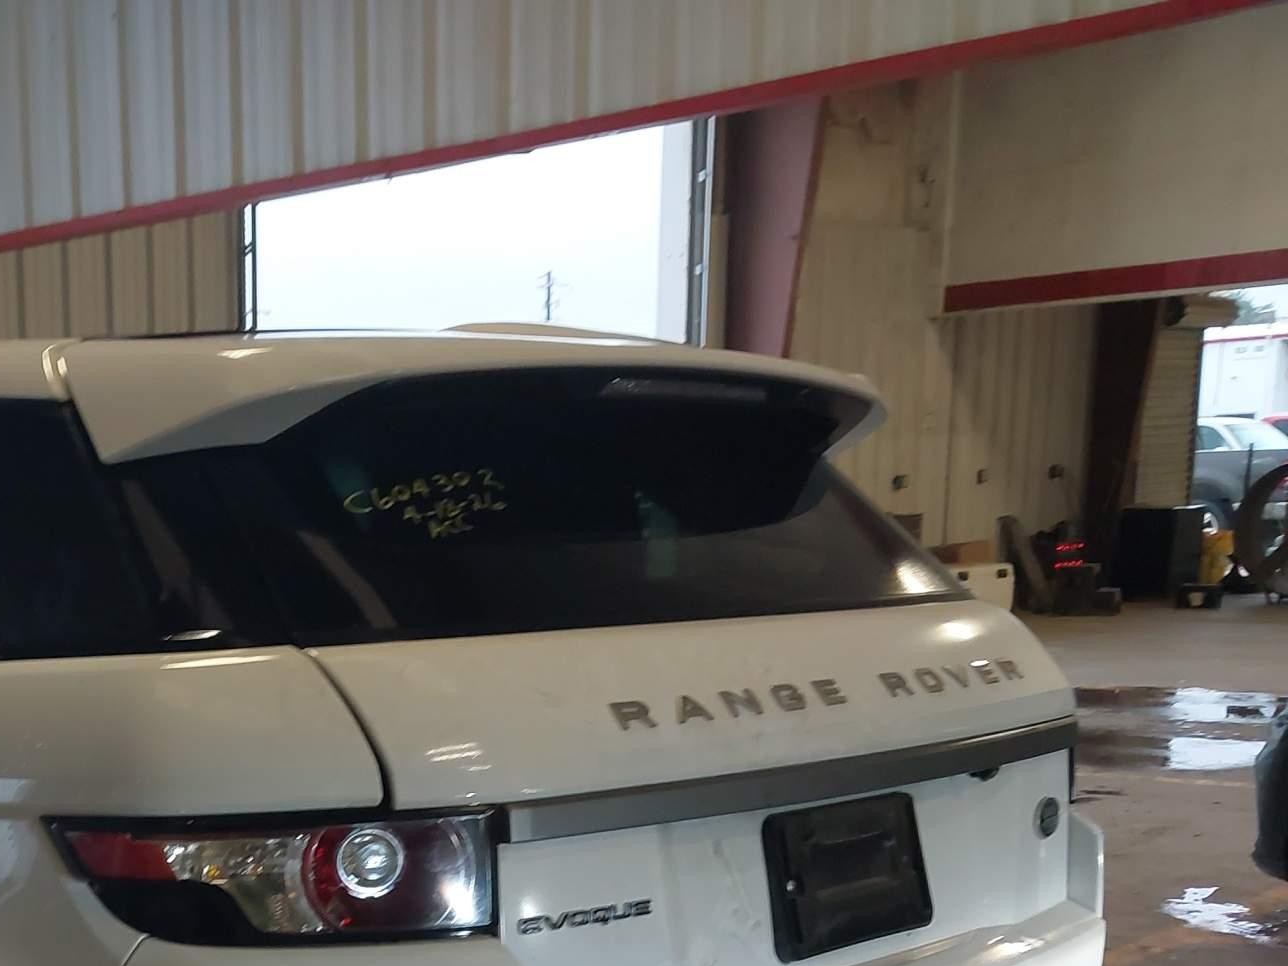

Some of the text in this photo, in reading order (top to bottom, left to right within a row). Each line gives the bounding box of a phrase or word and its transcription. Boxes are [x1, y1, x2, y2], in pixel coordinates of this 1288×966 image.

[609, 659, 1024, 731] RANGE ROVER
[517, 899, 653, 935] EVOQUE
